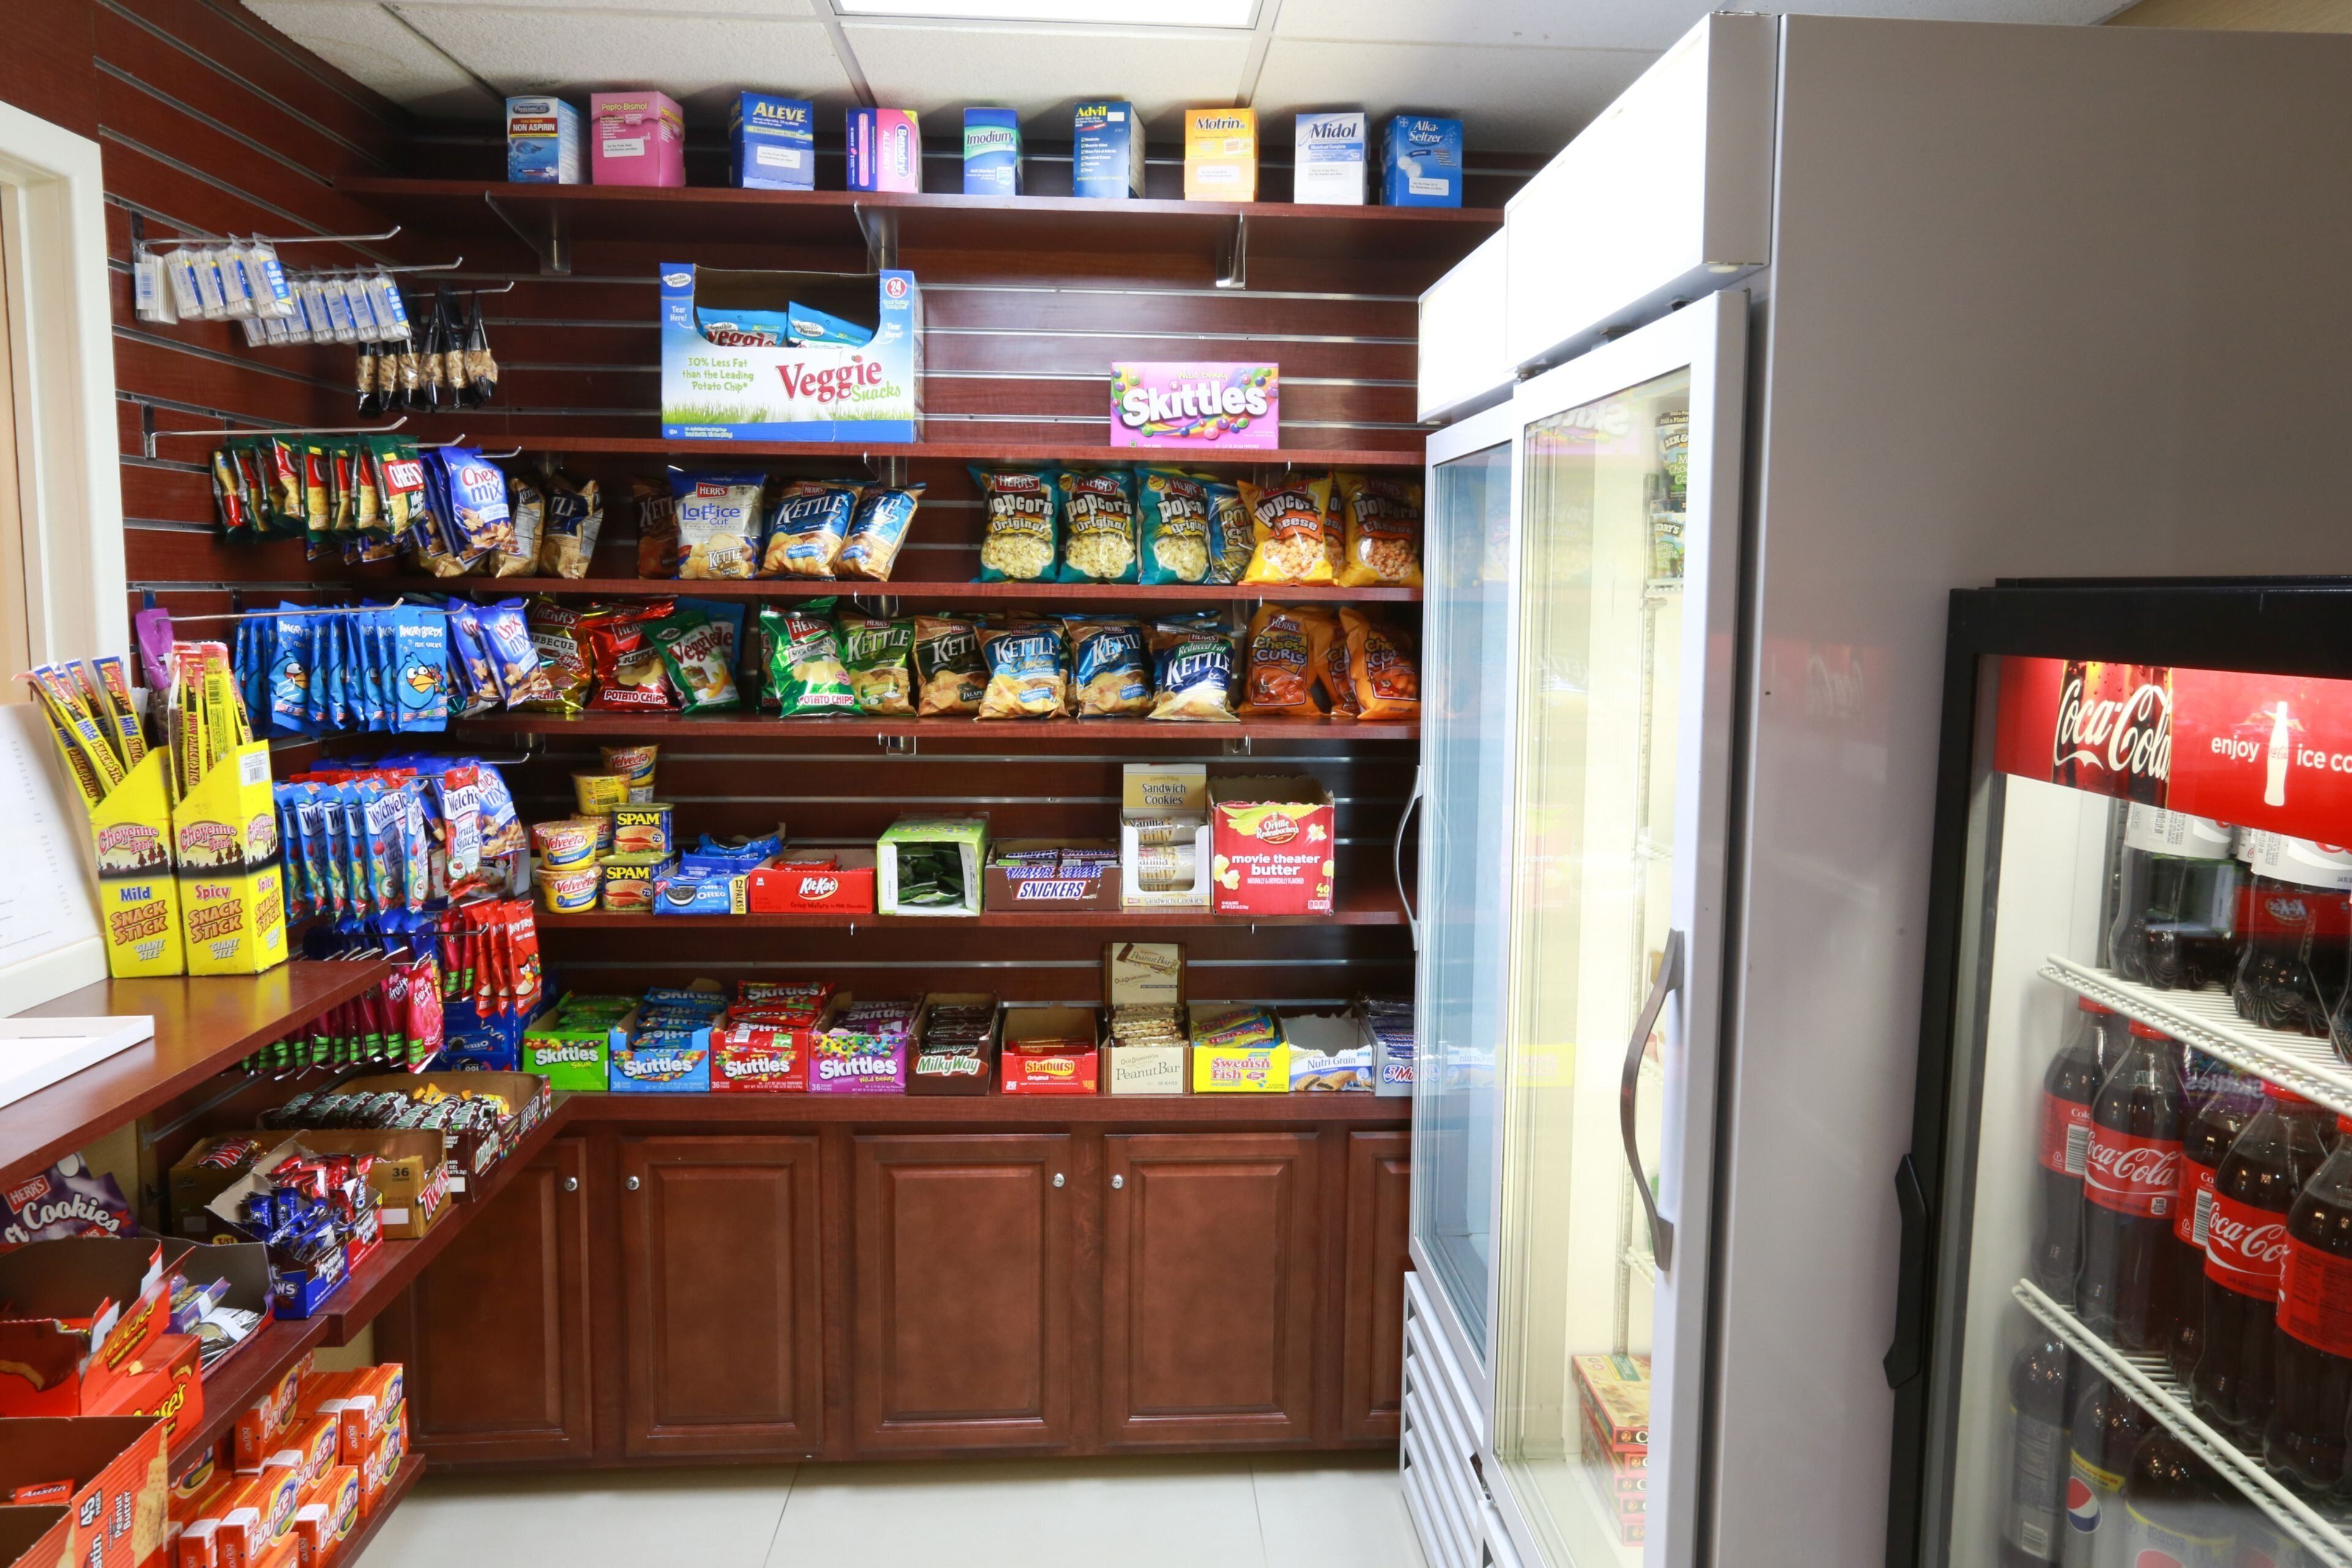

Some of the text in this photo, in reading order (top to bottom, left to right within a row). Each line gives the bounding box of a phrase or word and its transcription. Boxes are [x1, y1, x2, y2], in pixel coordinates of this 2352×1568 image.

[753, 102, 805, 123] ALEVE
[1076, 106, 1107, 117] Advil
[1195, 117, 1240, 130] Motrin
[1311, 123, 1356, 138] Midol
[967, 132, 1011, 145] Imodium
[1409, 132, 1442, 143] Seltzer
[897, 129, 907, 175] Benadryl
[891, 281, 902, 292] 24
[670, 314, 687, 322] Here!
[885, 330, 903, 339] Here!
[688, 358, 747, 368] 30% Less Fat
[682, 371, 754, 382] than the Leading
[775, 356, 883, 404] Veggie
[1177, 371, 1198, 380] Wild
[692, 382, 722, 391] Potato
[851, 380, 901, 402] Snacks
[1121, 380, 1268, 426] Skittles
[461, 466, 499, 486] Chex
[998, 476, 1035, 488] HERR'S
[471, 481, 503, 503] mix
[699, 487, 725, 496] HERR'S
[805, 485, 824, 494] HERR'S
[682, 502, 741, 521] Lattice
[777, 496, 845, 524] KETTLE
[709, 516, 728, 526] Cut
[992, 517, 1046, 533] Original
[1076, 515, 1126, 531] Original
[709, 548, 742, 570] KETTLE
[538, 607, 575, 624] HERR'S
[399, 625, 442, 638] ANGRY BIRDS
[1271, 618, 1297, 631] HERR'S
[846, 630, 911, 663] KETTLE
[1178, 643, 1226, 656] Reduced Fat
[1256, 636, 1307, 654] Cheese
[1256, 649, 1306, 665] CURLS
[1164, 651, 1231, 687] KETTLE
[605, 691, 668, 704] POTATO CHIPS
[800, 695, 854, 704] POTATO CHIPS
[118, 715, 139, 736] Mild
[2053, 678, 2172, 781] Coca-Cola
[77, 720, 113, 769] Mild SNACK
[2211, 735, 2326, 769] enjoy ice
[611, 753, 649, 766] Velveeta
[80, 774, 99, 798] STICK
[1142, 784, 1186, 793] Sandwich
[447, 786, 479, 815] Welch's
[1145, 795, 1183, 805] Cookies
[617, 813, 660, 826] SPAM
[1129, 819, 1164, 828] Vanilla
[1264, 820, 1289, 829] Orville
[179, 824, 236, 853] Cheyenne
[247, 816, 274, 848] Cheyenne
[458, 821, 475, 841] Fruit
[1256, 826, 1299, 839] Redenbacher's
[97, 825, 159, 855] Cheyenne
[129, 839, 155, 854] Brand
[209, 837, 233, 852] Brand
[456, 832, 481, 853] Snacks
[545, 834, 585, 850] Velveeta
[558, 854, 579, 863] ORIGINAL
[1232, 853, 1321, 864] movie theater
[606, 867, 650, 880] SPAM
[1251, 864, 1301, 875] butter
[195, 884, 230, 900] Spicy
[257, 876, 274, 892] Spicy
[556, 876, 595, 892] Velveeta
[735, 880, 743, 888] 12
[1019, 882, 1085, 897] SNICKERS
[1316, 883, 1330, 894] 40
[120, 886, 151, 902] Mild
[570, 895, 592, 905] ORIGINAL
[696, 891, 726, 900] OREO
[254, 888, 280, 921] SNACK
[791, 901, 807, 910] Crisp
[808, 901, 829, 910] Wafers
[110, 900, 168, 930] SNACK
[188, 899, 243, 928] SNACK
[257, 902, 281, 937] STICK
[114, 916, 168, 946] STICK
[191, 914, 243, 943] STICK
[1131, 951, 1174, 967] Peanut Bar
[747, 987, 820, 1000] Skittles
[535, 1047, 599, 1066] Skittles
[1212, 1057, 1270, 1070] Swedish
[1307, 1056, 1355, 1070] Nutri Grain
[624, 1058, 693, 1077] Skittles
[725, 1056, 790, 1078] Skittles
[820, 1055, 897, 1079] Skittles
[1025, 1060, 1074, 1073] Starburst
[1116, 1061, 1180, 1080] Peanut Bar
[1212, 1070, 1242, 1080] Fish
[2086, 1129, 2182, 1187] Coca-Cola
[392, 1167, 409, 1177] 36
[10, 1177, 47, 1204] HERR'S
[417, 1163, 450, 1219] Twix
[23, 1194, 121, 1232] Cookies
[355, 1211, 374, 1238] Peanut
[318, 1247, 341, 1276] Peanut
[326, 1259, 345, 1283] Chews
[368, 1382, 400, 1441] bounce
[242, 1427, 252, 1452] bounce
[347, 1425, 358, 1449] bounce
[20, 1485, 67, 1499] Austin
[80, 1496, 95, 1527] 45
[319, 1487, 353, 1552] bounce
[249, 1489, 293, 1559] bounce
